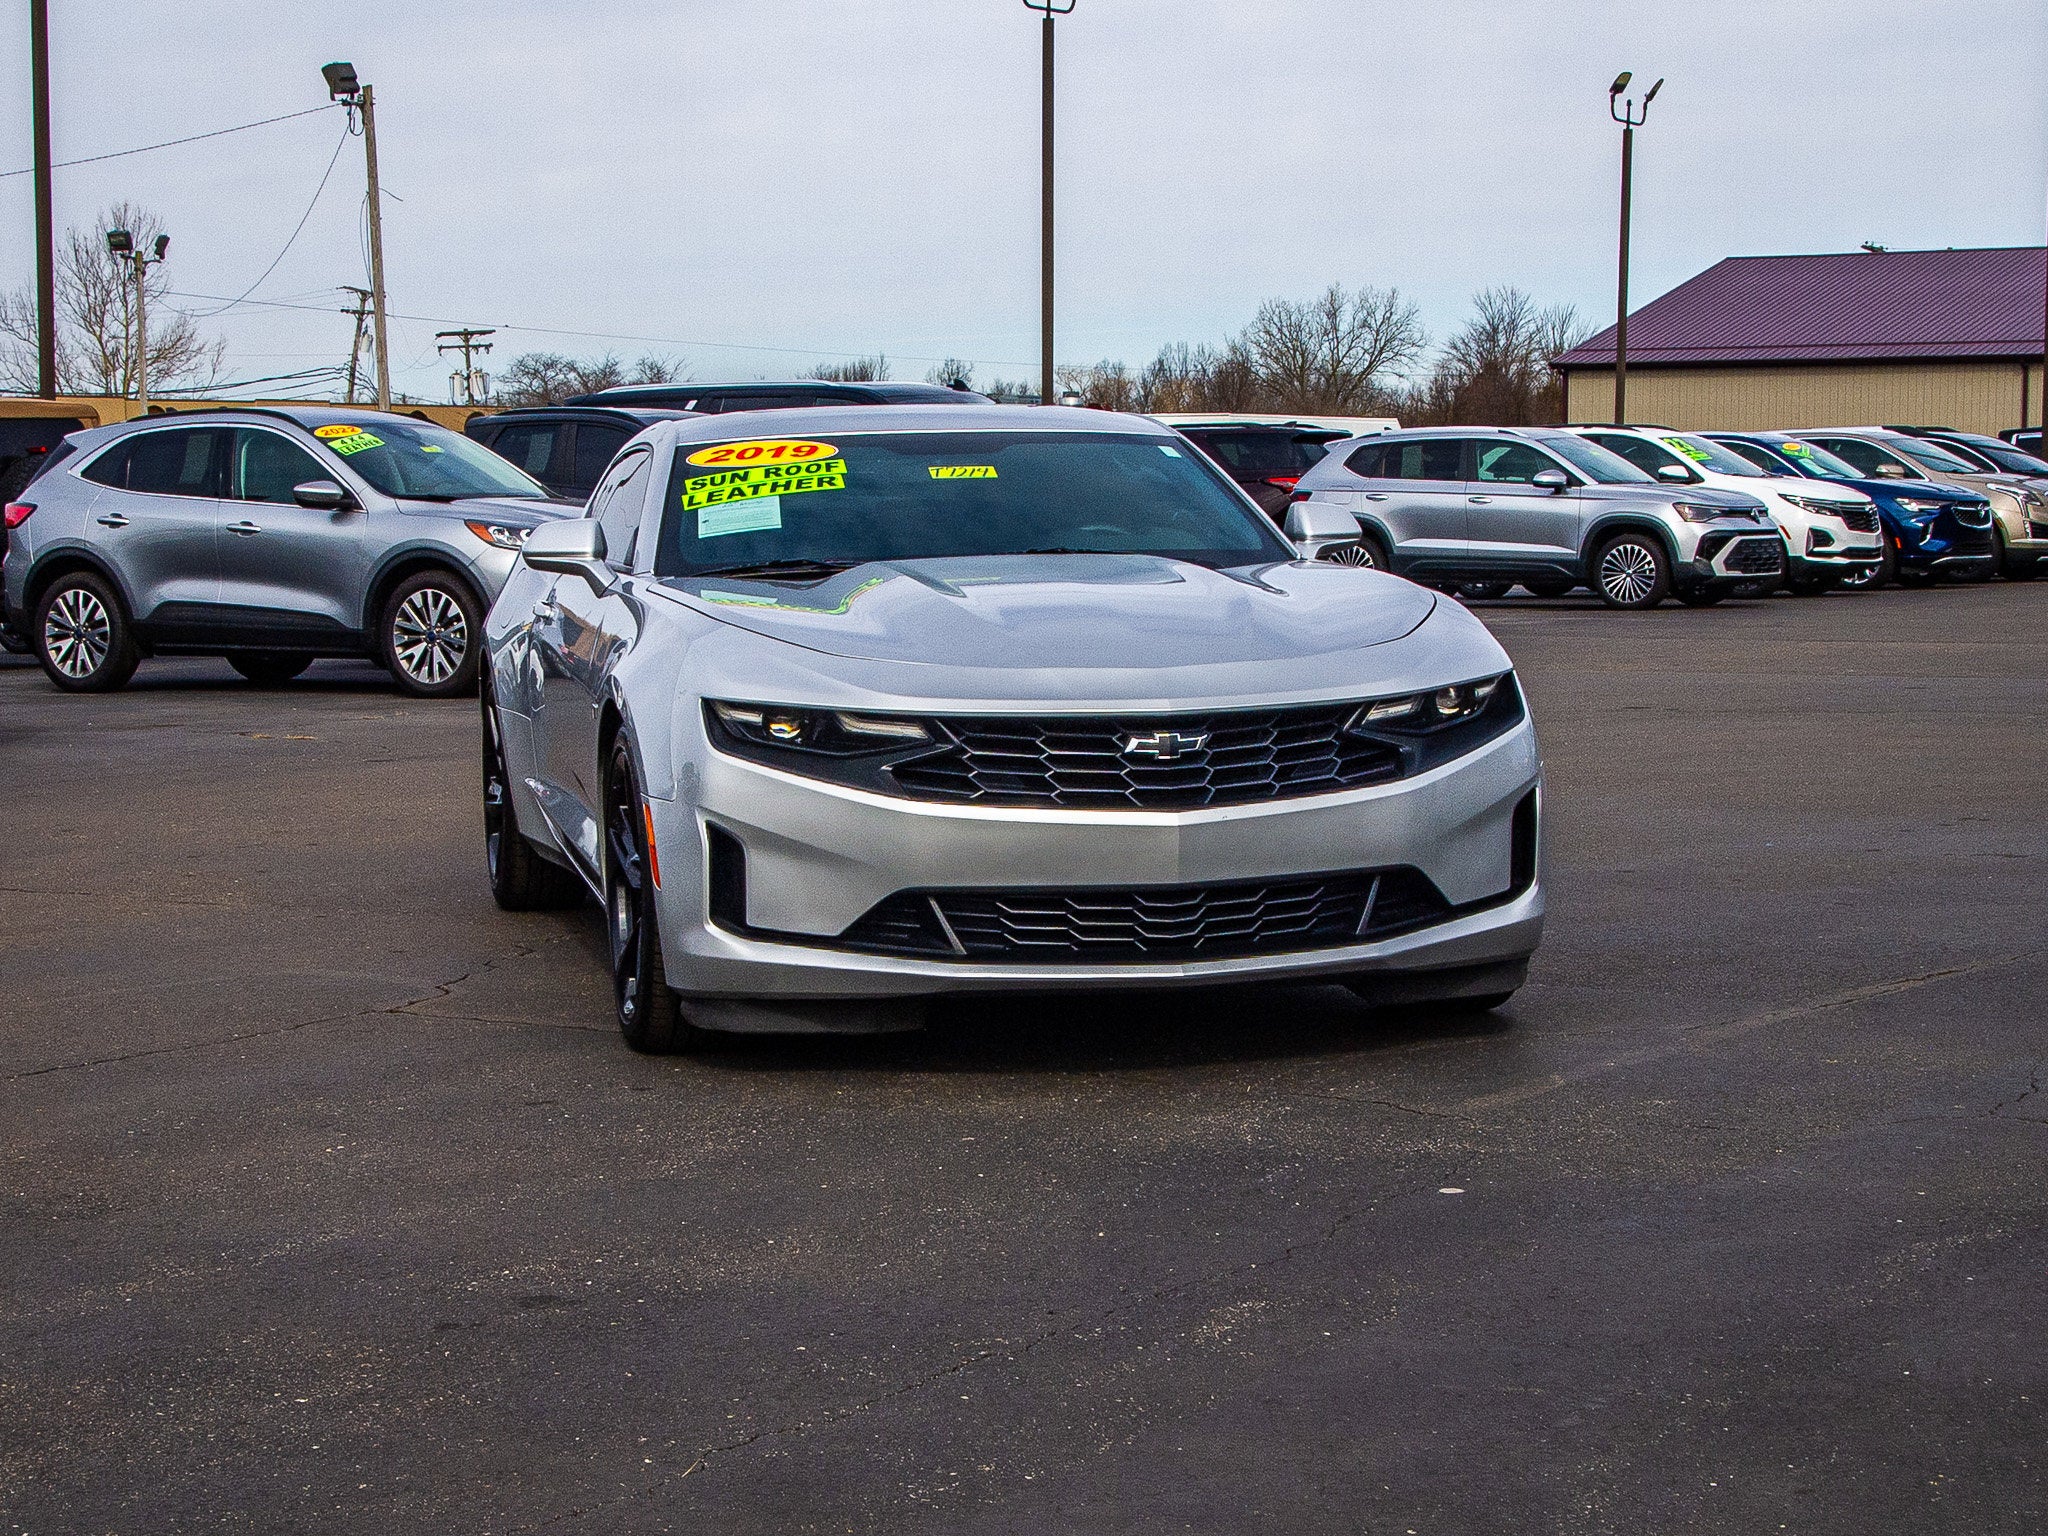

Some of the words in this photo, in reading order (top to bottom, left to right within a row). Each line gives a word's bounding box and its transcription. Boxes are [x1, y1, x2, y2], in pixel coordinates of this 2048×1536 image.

[321, 427, 359, 436] 2022
[341, 439, 380, 454] LEATHER
[704, 445, 819, 463] 2019
[690, 471, 750, 490] SUN
[764, 461, 840, 479] ROOF
[686, 476, 839, 507] LEATHER
